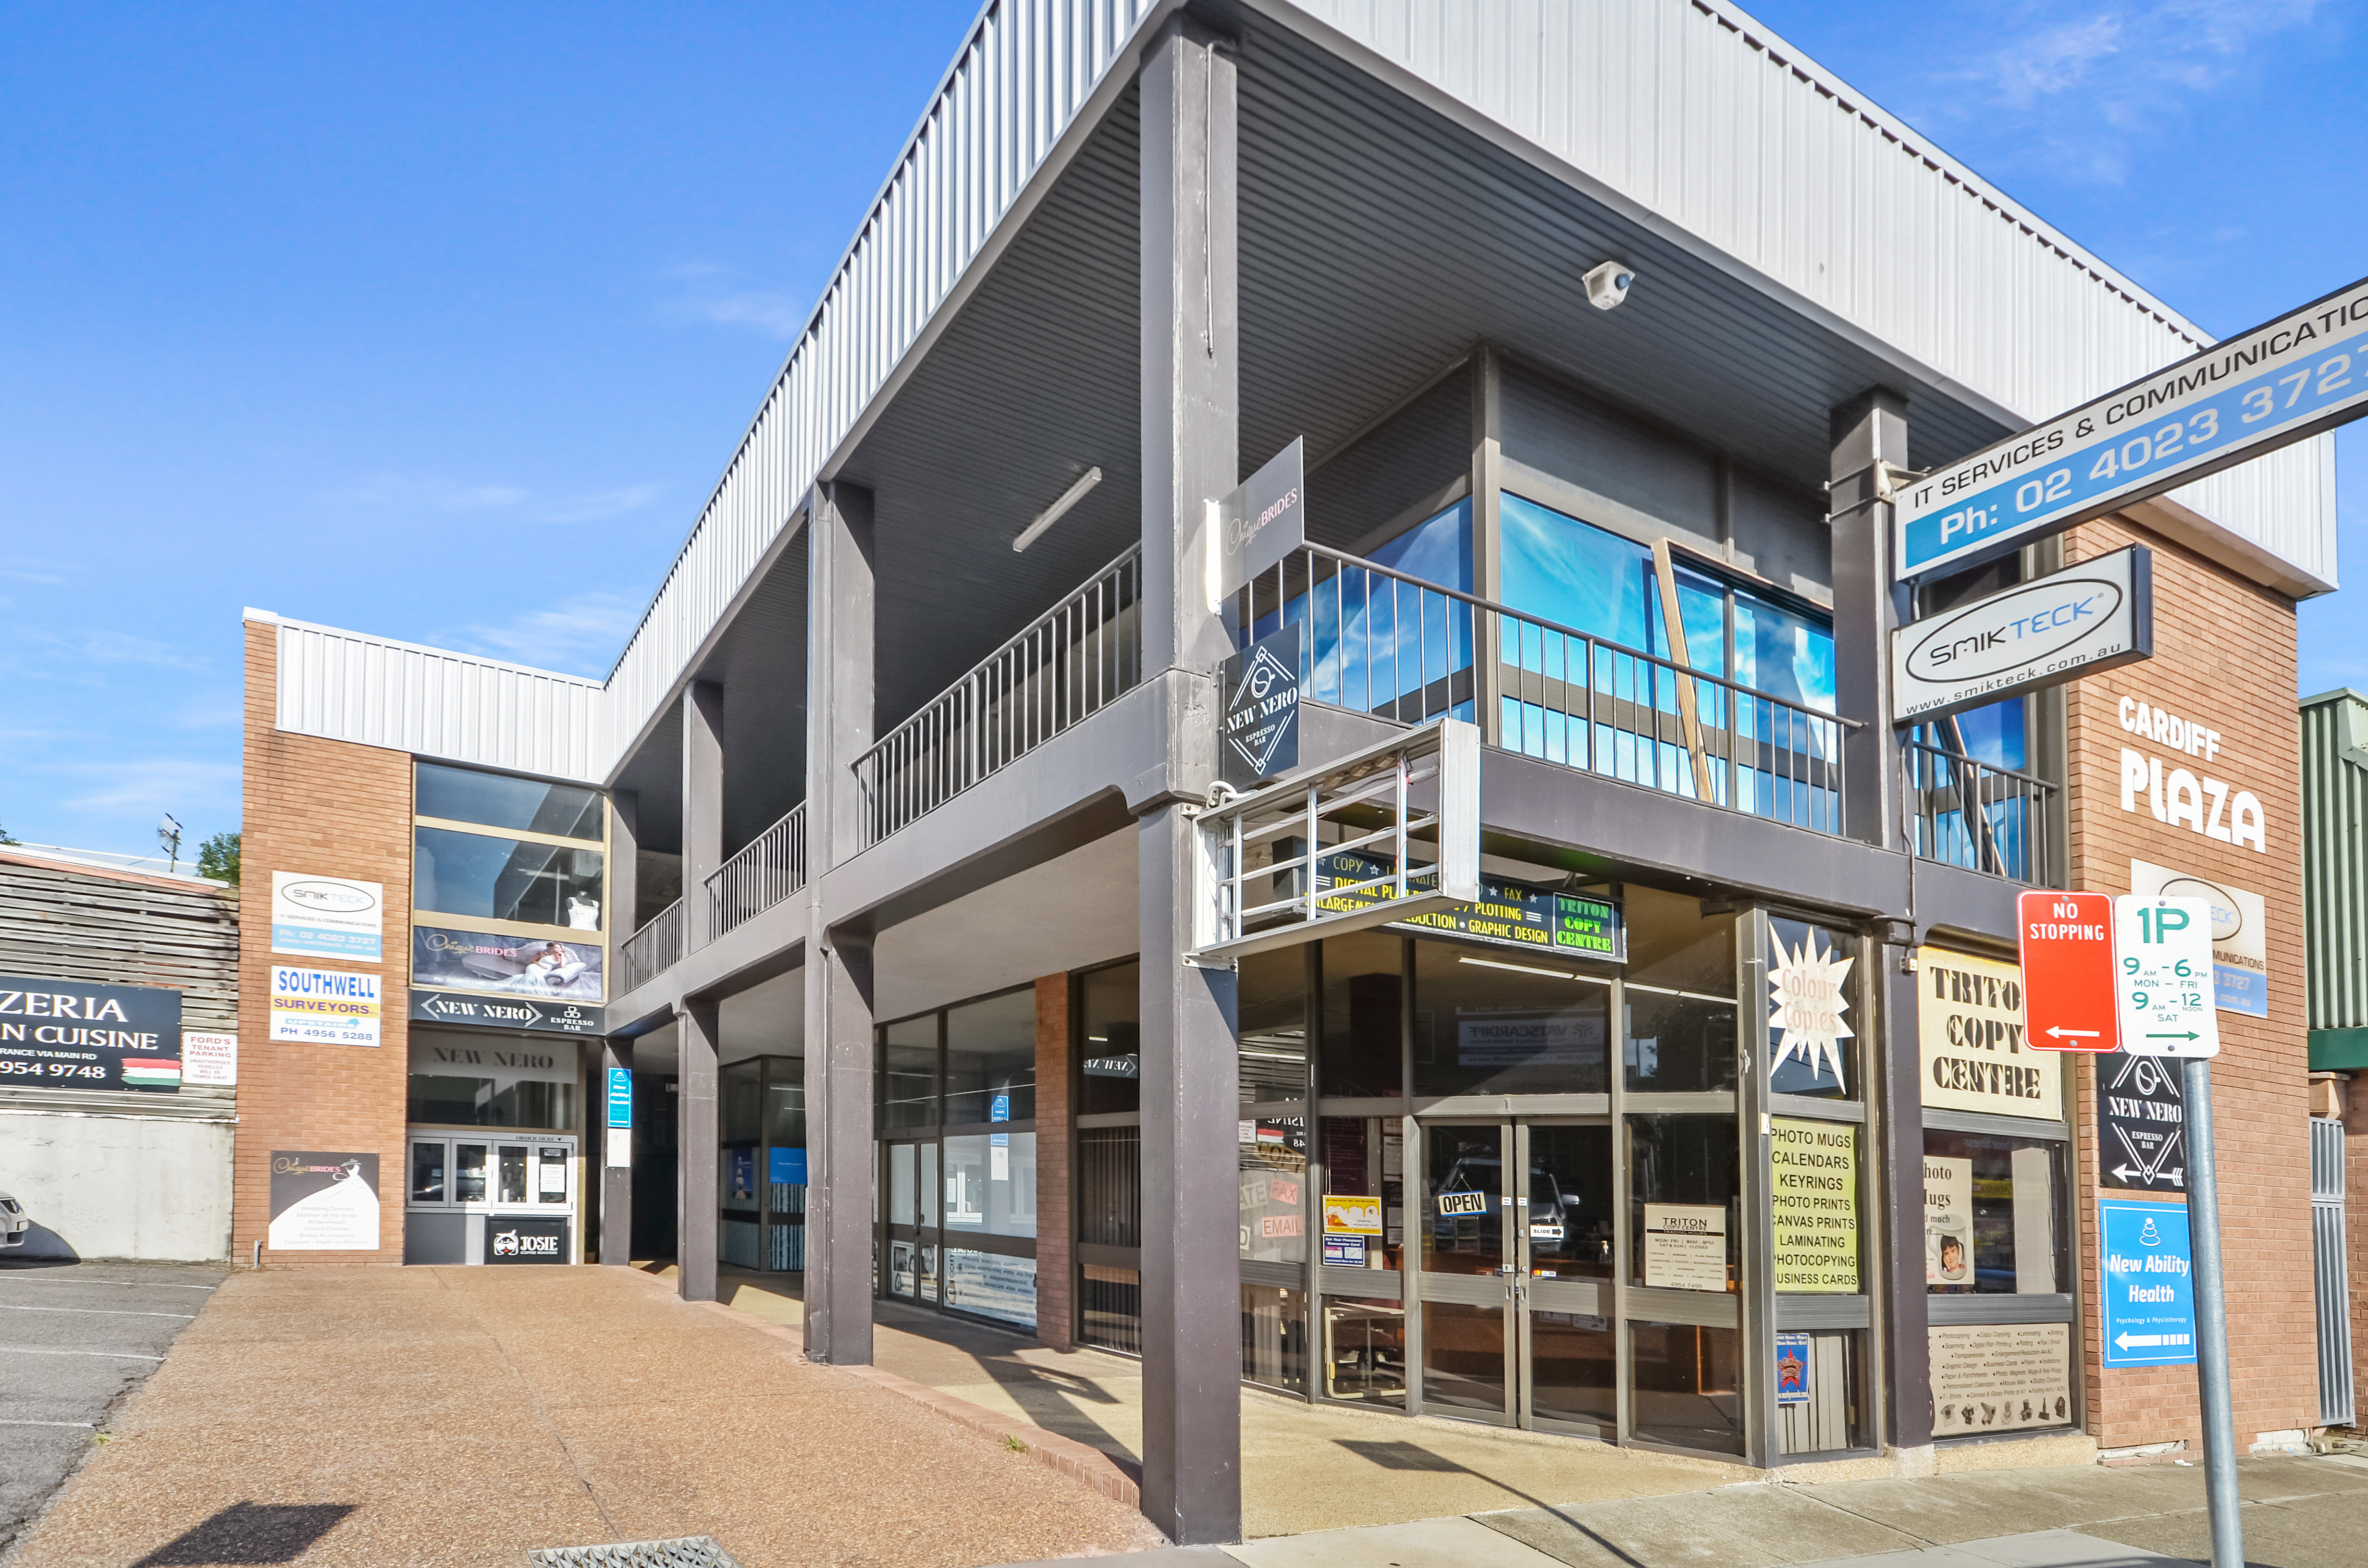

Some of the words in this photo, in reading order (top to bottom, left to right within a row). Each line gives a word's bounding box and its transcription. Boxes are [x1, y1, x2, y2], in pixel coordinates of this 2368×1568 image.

[1915, 486, 1933, 508] IT
[1942, 430, 2063, 496] SERVICES
[2075, 417, 2095, 439] &
[1941, 504, 1998, 545] Ph:
[2016, 468, 2072, 513] 02
[2090, 409, 2219, 479] 4023
[1907, 643, 2120, 714] www.smikteck.com.au
[1227, 705, 1257, 734] NEW
[1260, 687, 1297, 718] NERO
[1246, 724, 1275, 743] ESPRESSO
[2120, 696, 2220, 762] CARDIFF
[1254, 736, 1266, 747] BAR
[2121, 747, 2265, 854] PLAZA
[1333, 856, 1364, 873] COPY
[1504, 887, 1522, 902] FAX
[1475, 903, 1521, 921] PLOTTING
[1558, 897, 1609, 919] TRITON
[2054, 903, 2078, 919] NO
[323, 919, 377, 928] COMMUNICATIONS
[1468, 919, 1511, 938] GRAPHIC
[1515, 926, 1548, 944] DESIGN
[1564, 916, 1602, 933] COPY
[2030, 923, 2104, 941] STOPPING
[2137, 907, 2190, 943] 1P
[317, 933, 346, 943] 4023
[348, 936, 376, 945] 3727
[1556, 931, 1612, 951] CENTRE
[2123, 957, 2140, 975] 9
[2175, 959, 2191, 977] 6
[279, 970, 374, 998] SOUTHWELL
[1782, 968, 1837, 1002] Colour
[2134, 980, 2159, 988] MON
[2223, 973, 2250, 991] 3727
[274, 998, 370, 1014] SURVEYORS
[2132, 992, 2149, 1010] 9
[2182, 993, 2202, 1006] 12
[435, 1000, 478, 1016] NEW
[483, 1004, 532, 1021] NERO
[1784, 1002, 1837, 1035] Copies
[2158, 1014, 2178, 1022] SAT
[550, 1017, 594, 1027] ESPRESSO
[34, 1025, 160, 1050] CUISINE
[191, 1037, 231, 1045] FORD'S
[304, 1029, 335, 1038] 4956
[342, 1032, 372, 1041] 5288
[1947, 1015, 2024, 1054] COPY
[37, 1049, 54, 1058] VIA
[55, 1051, 81, 1060] MAIN
[434, 1047, 485, 1064] NEW
[494, 1052, 554, 1069] NERO
[49, 1063, 107, 1079] 9748
[1933, 1056, 2041, 1099] CENTRE
[2109, 1096, 2143, 1119] NEW
[2146, 1101, 2183, 1123] NERO
[1772, 1128, 1813, 1145] PHOTO
[1817, 1133, 1851, 1148] MUGS
[2132, 1131, 2163, 1142] ESPRESSO
[2141, 1141, 2155, 1150] BAR
[1772, 1151, 1849, 1170] CALENDARS
[1273, 1181, 1296, 1202] FAX
[1779, 1174, 1843, 1191] KEYRINGS
[1443, 1193, 1483, 1213] OPEN
[1773, 1195, 1811, 1208] PHOTO
[1813, 1198, 1850, 1211] PRINTS
[1263, 1217, 1302, 1235] EMAIL
[1663, 1217, 1707, 1227] TRITON
[1817, 1217, 1855, 1230] PRINTS
[1930, 1214, 1950, 1224] much
[520, 1237, 558, 1251] JOSIE
[1780, 1234, 1845, 1248] LAMINATING
[1774, 1253, 1855, 1267] HOTOCOPYING
[2110, 1254, 2143, 1273] New
[2145, 1255, 2190, 1277] Ability
[1775, 1273, 1819, 1284] USINESS
[1822, 1274, 1857, 1285] CARDS
[2129, 1285, 2174, 1303] Health
[2116, 1317, 2145, 1325] Psychology
